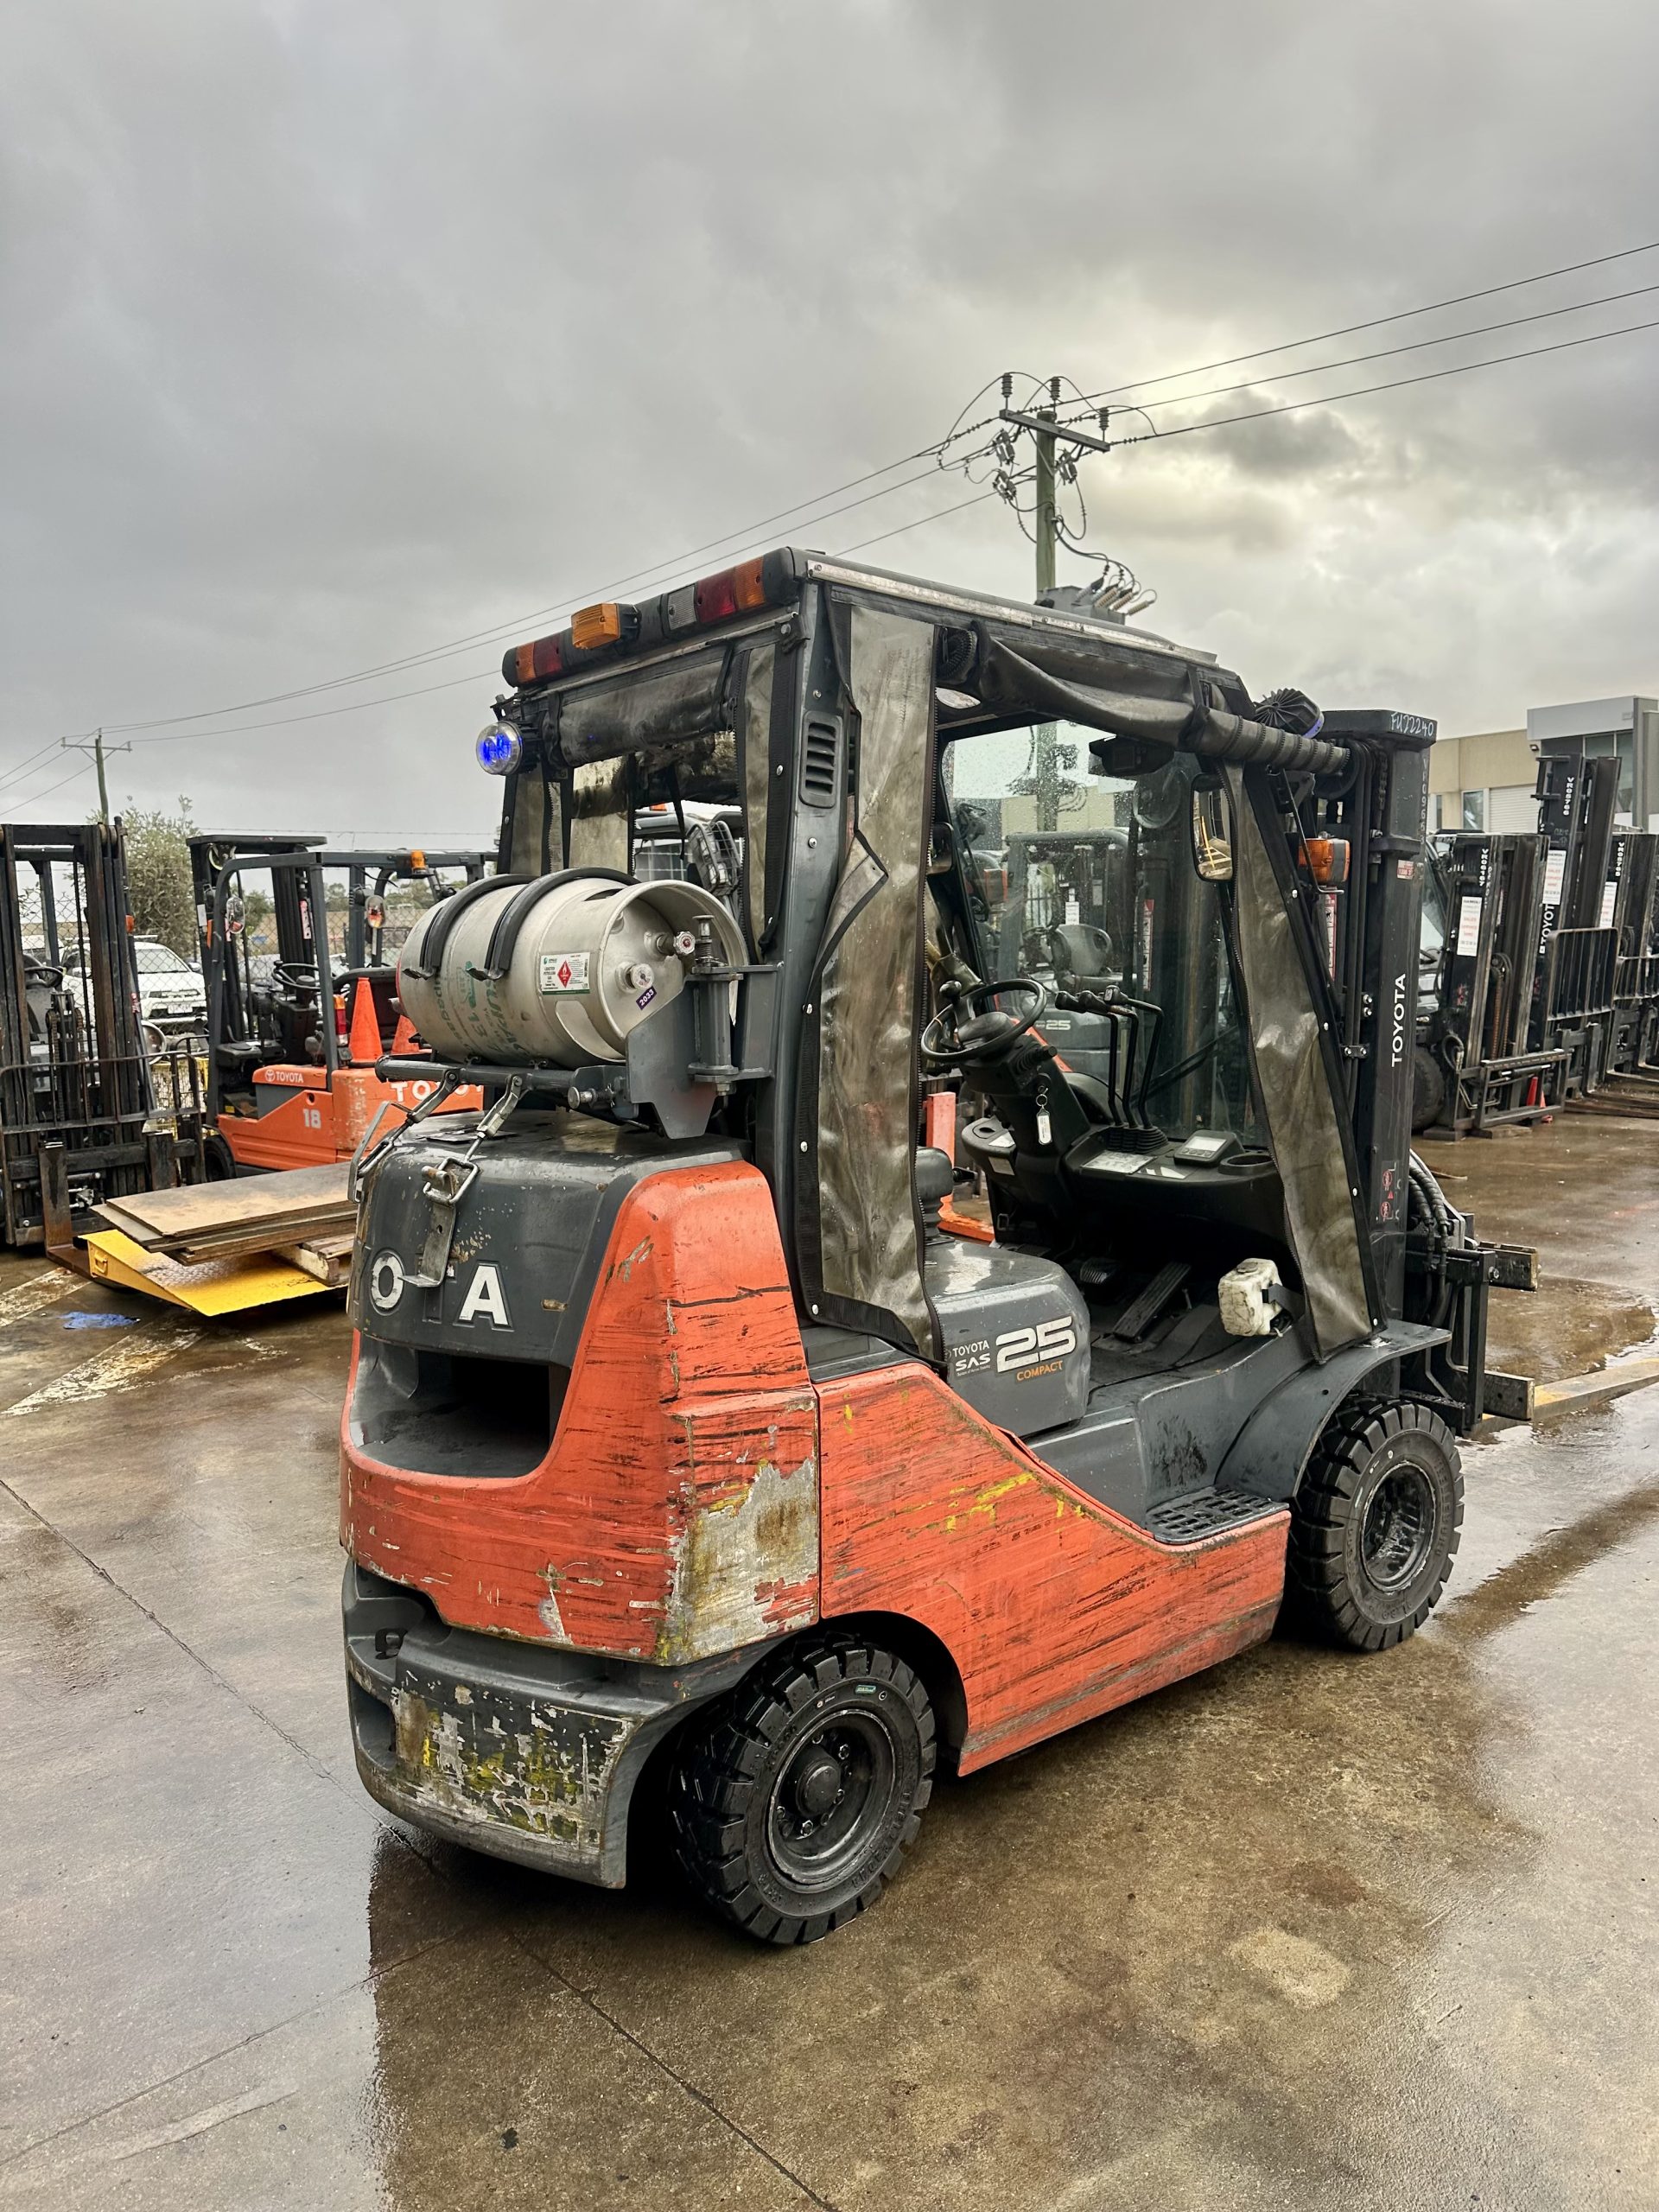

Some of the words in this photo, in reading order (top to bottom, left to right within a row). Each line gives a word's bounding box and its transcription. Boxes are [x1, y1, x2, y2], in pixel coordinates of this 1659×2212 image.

[1541, 904, 1554, 944] TOYOT
[639, 989, 654, 1006] 2033
[1046, 1020, 1071, 1030] 25
[1391, 973, 1406, 1067] TOYOTA
[276, 1071, 303, 1083] TOYOTA
[303, 1109, 321, 1128] 18
[952, 1340, 989, 1357] TOYOTA
[996, 1316, 1076, 1372] 25
[956, 1353, 991, 1372] SAS
[1016, 1360, 1064, 1382] COMPACT
